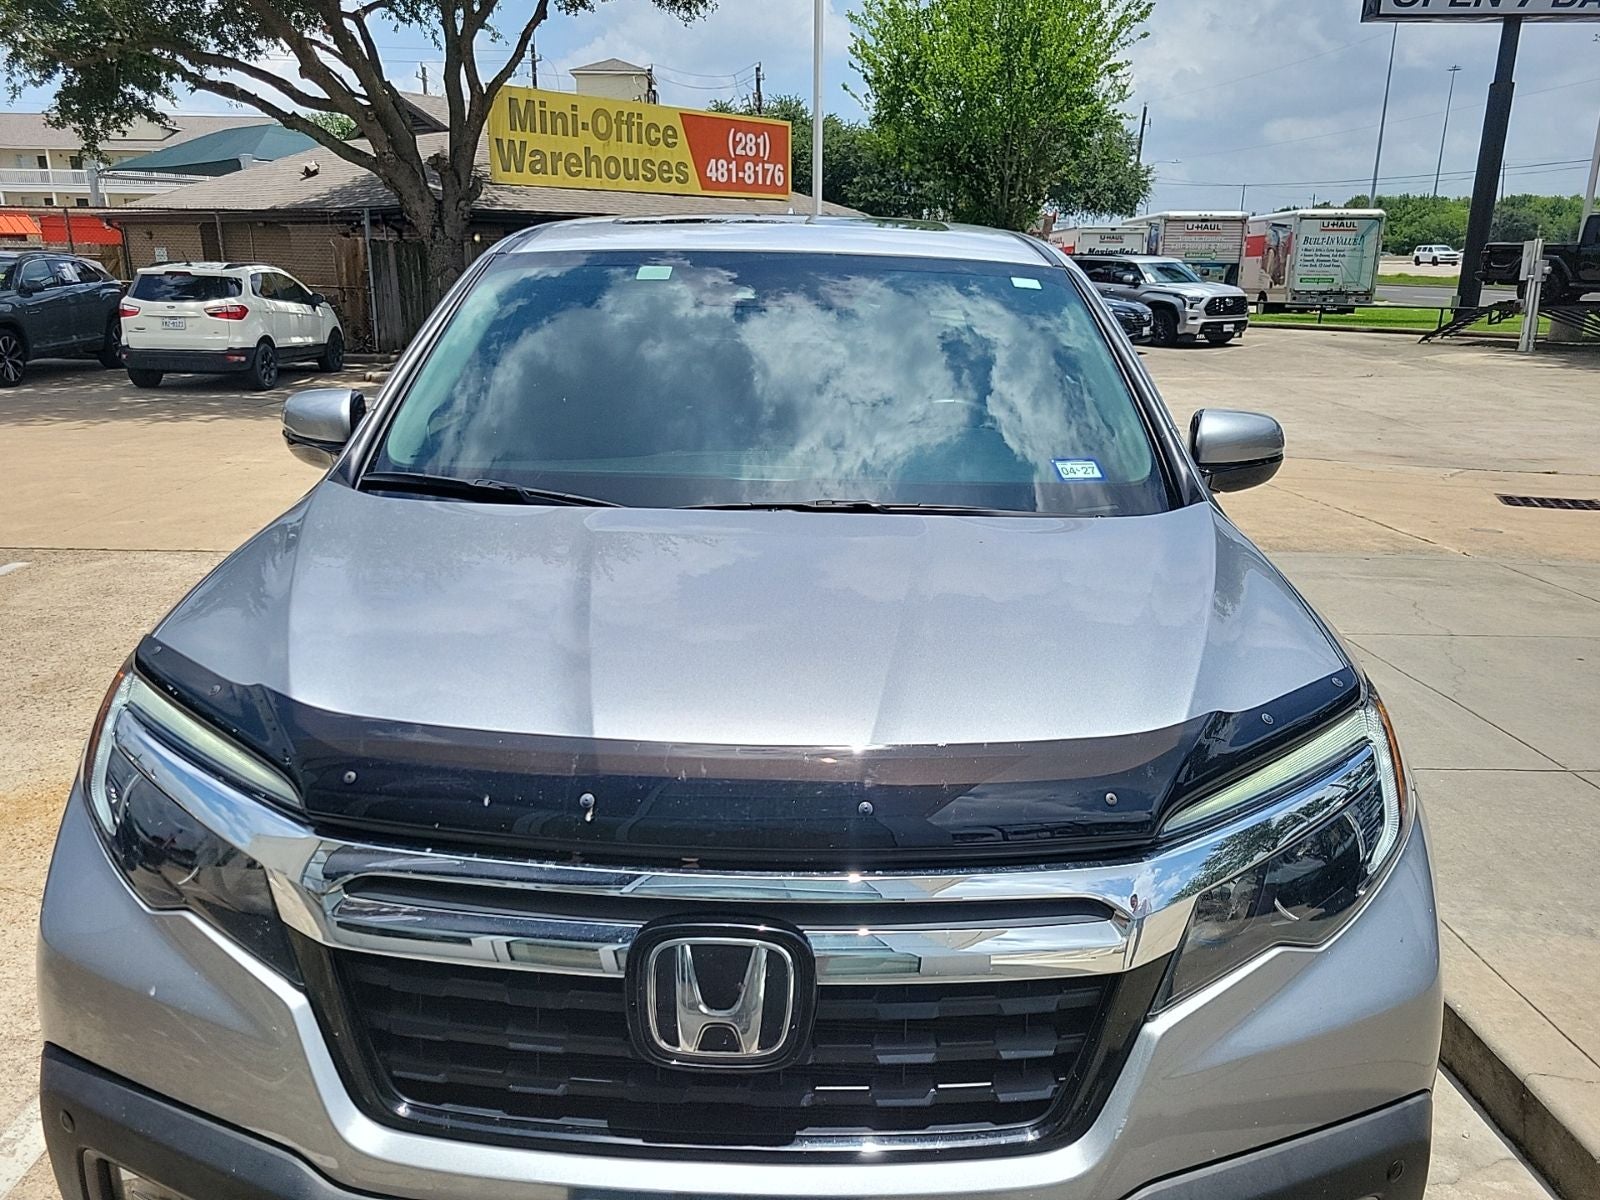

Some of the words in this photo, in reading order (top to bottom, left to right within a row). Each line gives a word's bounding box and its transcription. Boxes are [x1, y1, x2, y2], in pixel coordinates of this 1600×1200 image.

[508, 97, 678, 148] Mini-Office
[728, 128, 770, 161] (281)
[495, 138, 690, 185] Warehouses
[706, 158, 785, 187] 481-8176
[1186, 223, 1222, 231] U-HAUL
